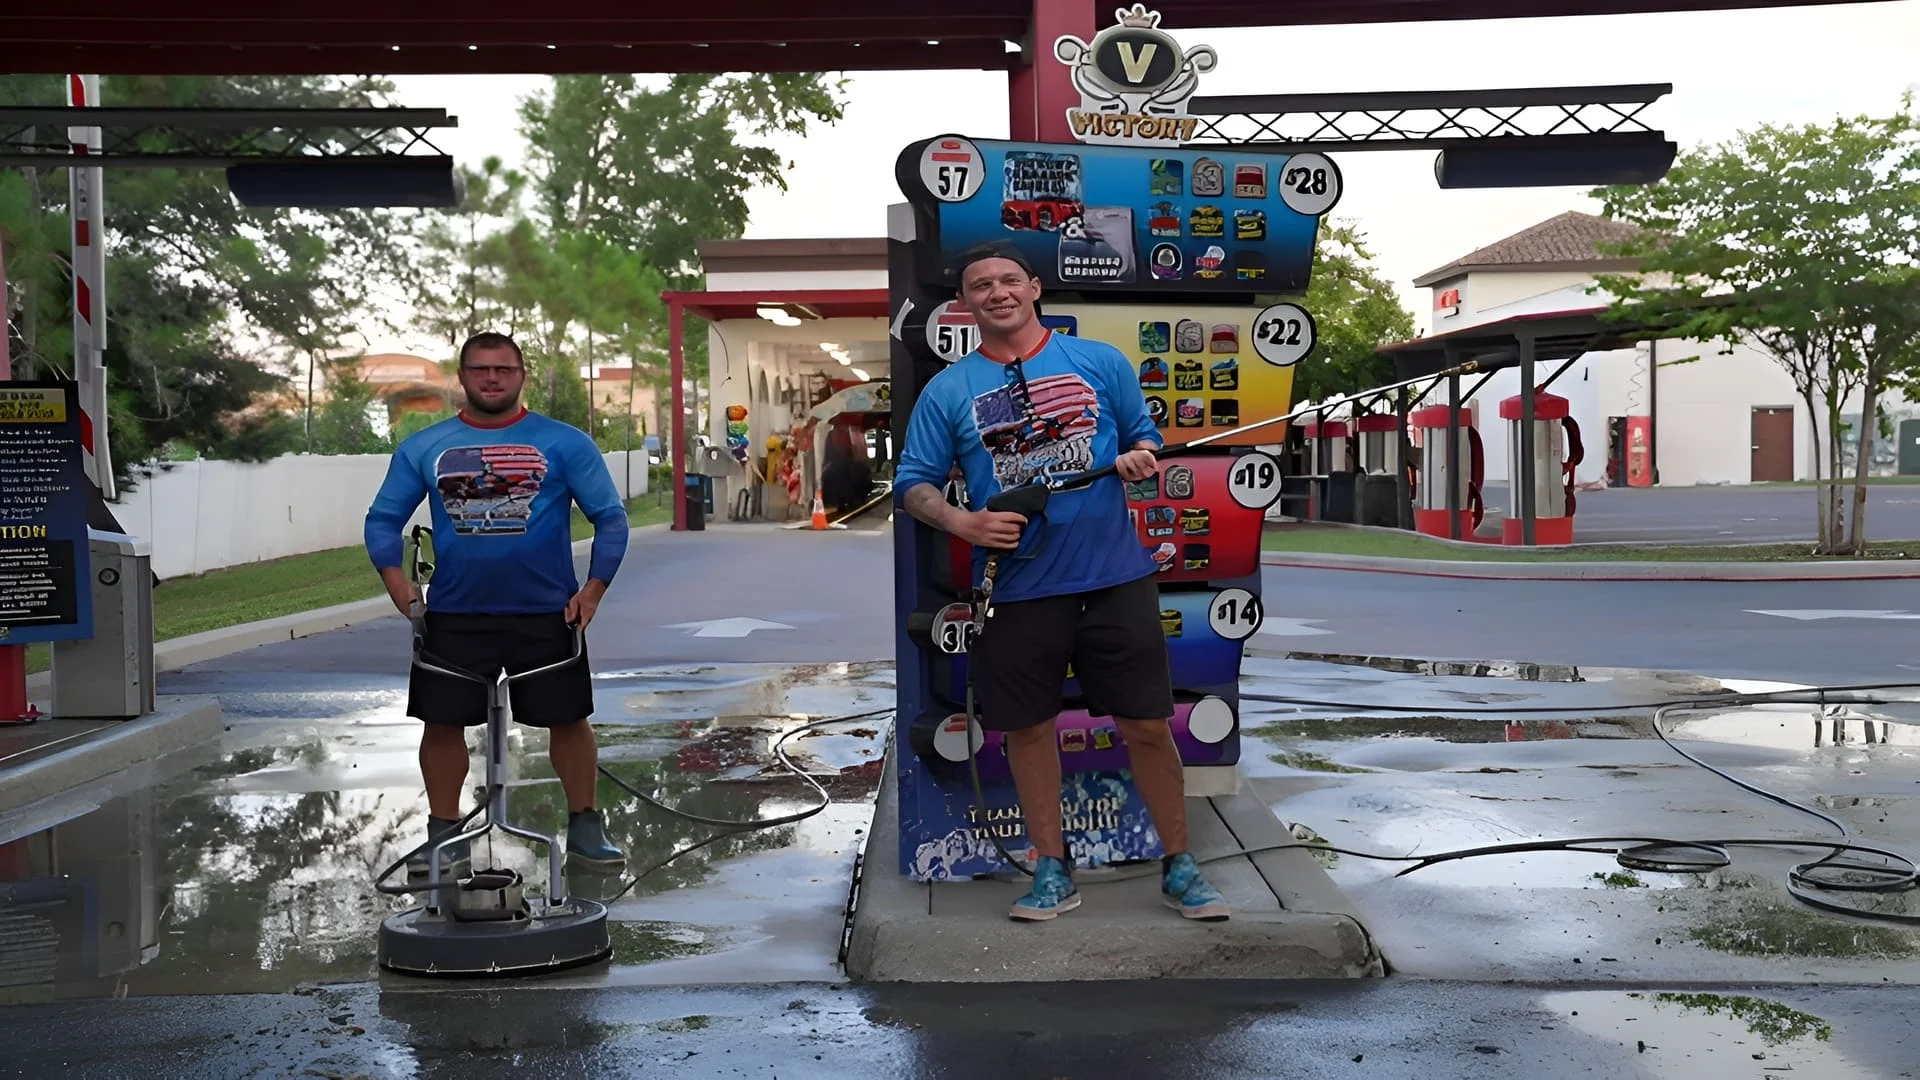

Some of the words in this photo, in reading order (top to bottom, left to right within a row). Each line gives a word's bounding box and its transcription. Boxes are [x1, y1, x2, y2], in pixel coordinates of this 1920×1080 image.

[1117, 41, 1158, 83] V
[1070, 110, 1198, 141] VICTORY
[938, 166, 968, 196] 57
[1285, 167, 1327, 195] $28
[938, 326, 968, 355] 51
[1257, 318, 1301, 346] $22
[1235, 463, 1274, 489] $19
[1218, 598, 1257, 626] $14
